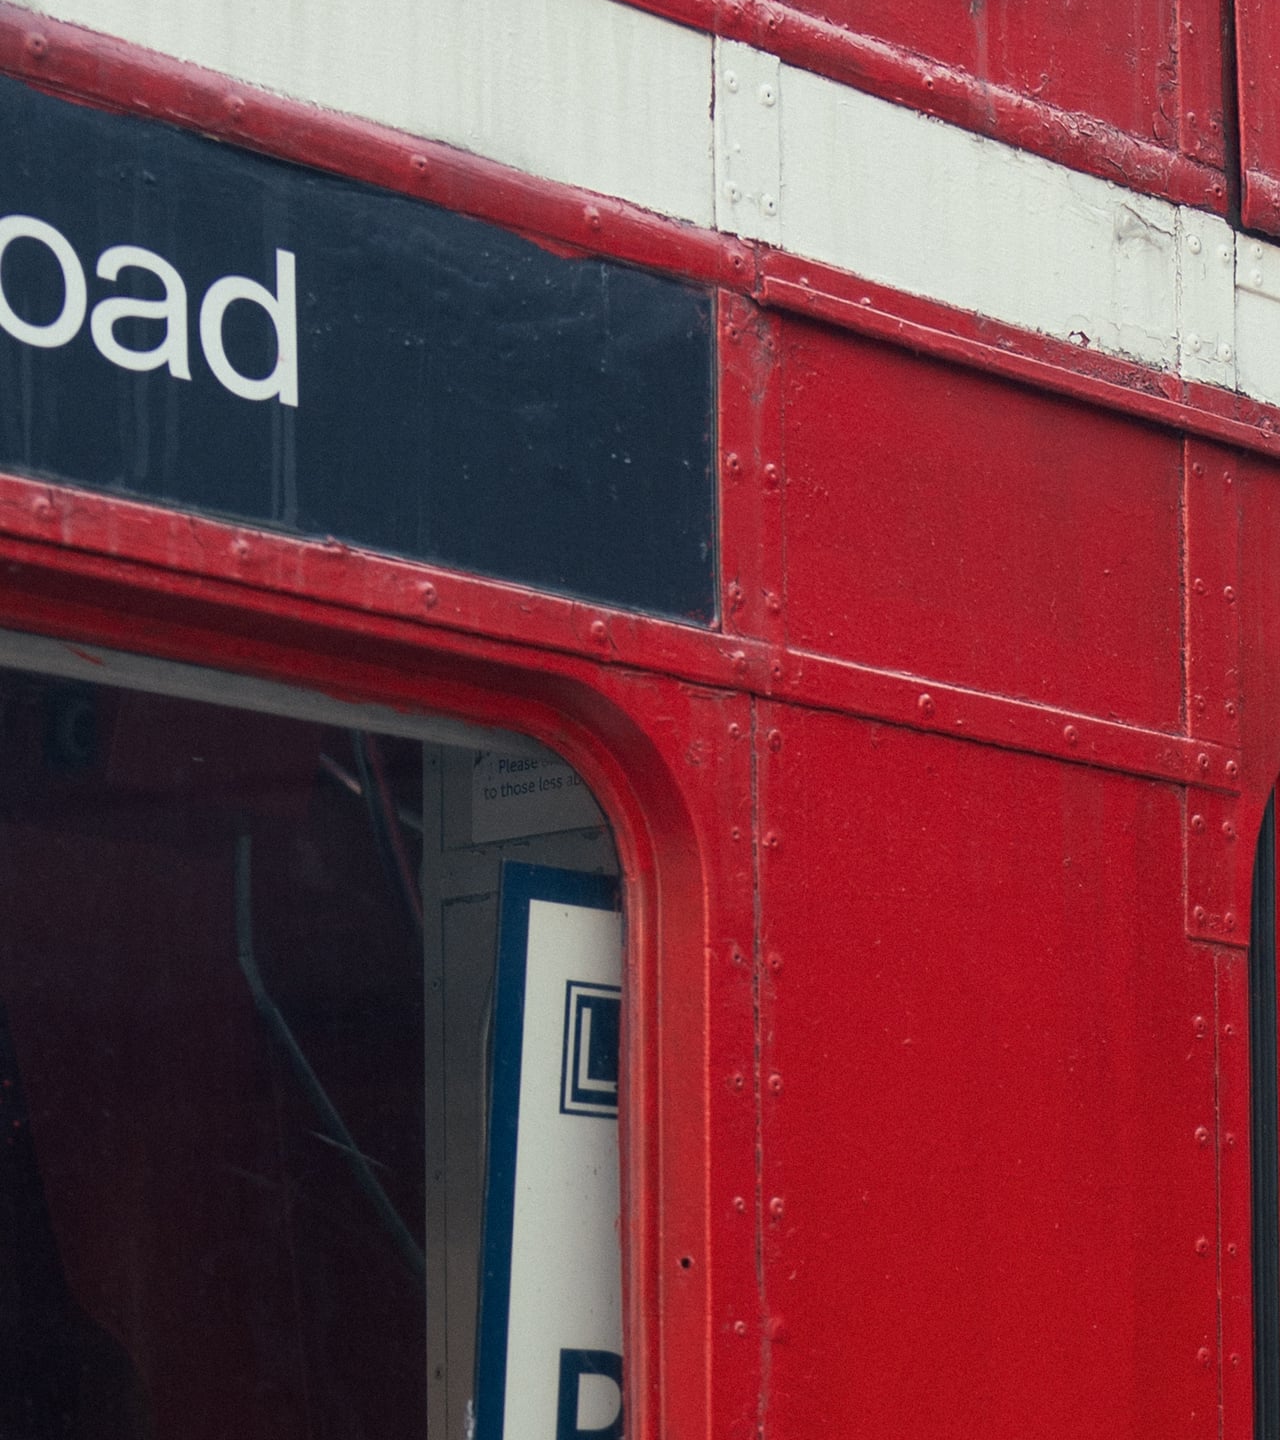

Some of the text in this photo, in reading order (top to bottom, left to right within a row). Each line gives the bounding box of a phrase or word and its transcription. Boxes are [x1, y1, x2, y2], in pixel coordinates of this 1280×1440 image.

[498, 758, 538, 774] Please
[484, 787, 498, 800] to
[500, 780, 536, 798] those
[539, 776, 563, 792] less
